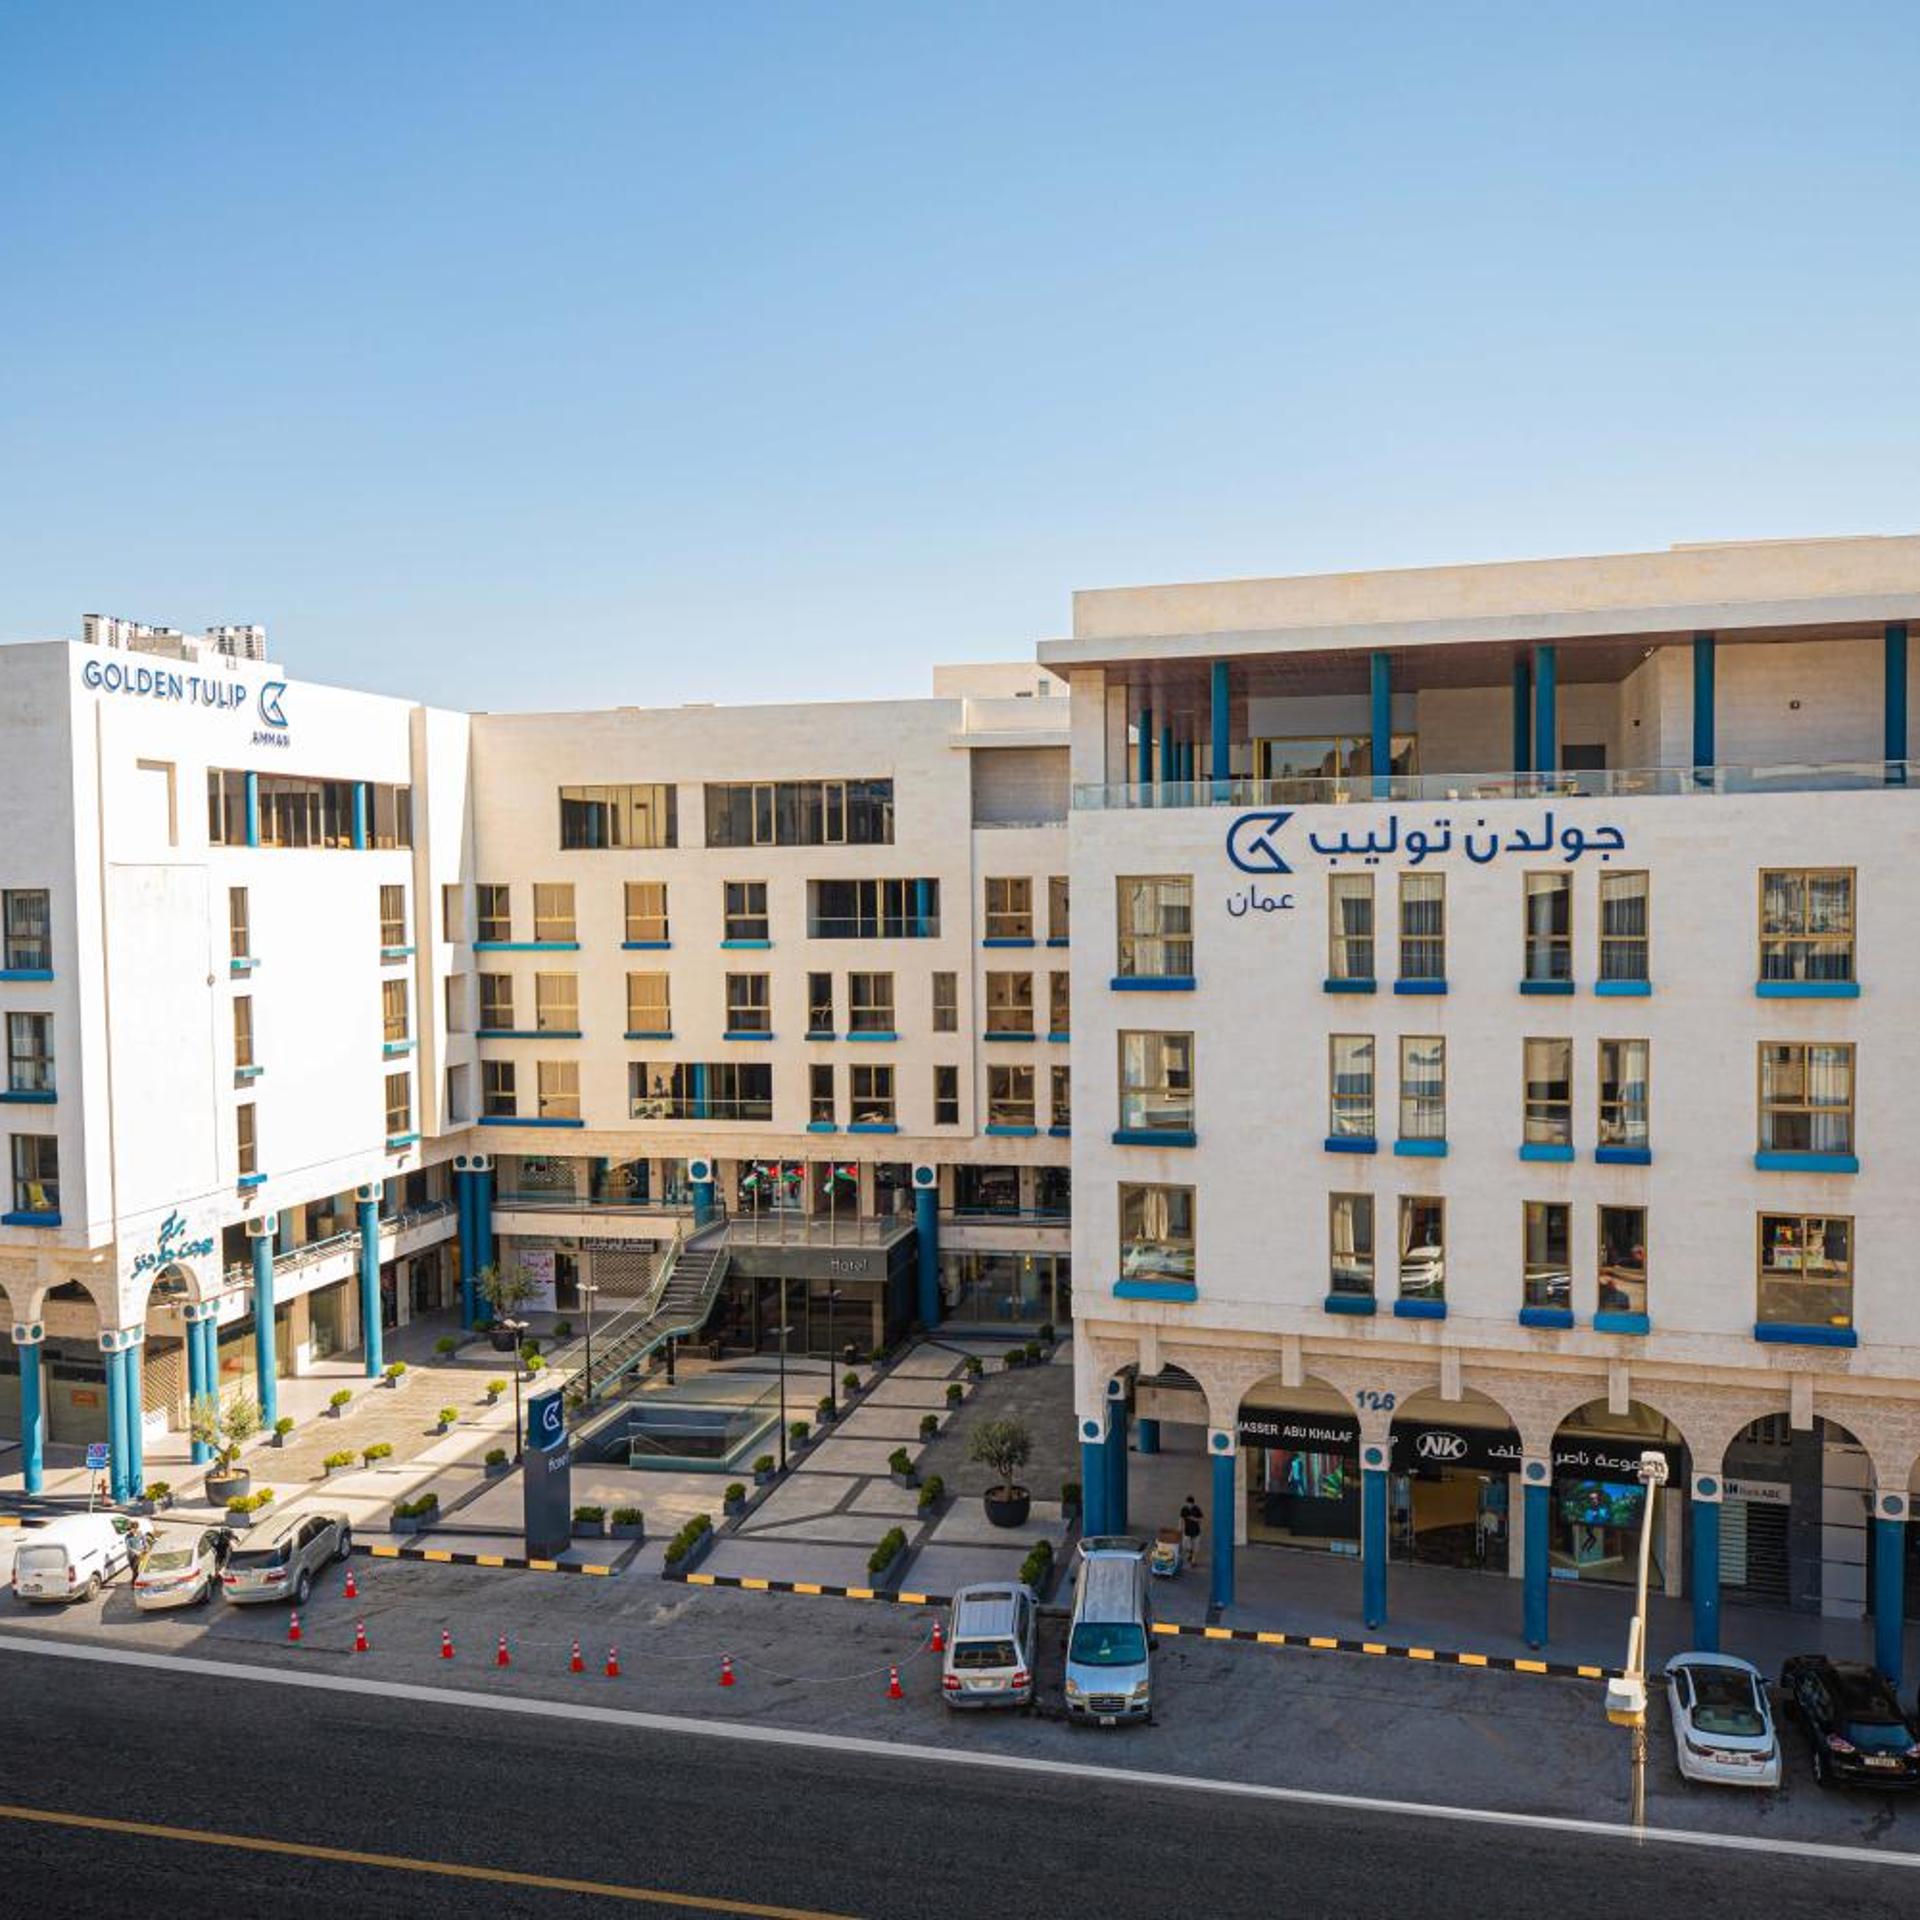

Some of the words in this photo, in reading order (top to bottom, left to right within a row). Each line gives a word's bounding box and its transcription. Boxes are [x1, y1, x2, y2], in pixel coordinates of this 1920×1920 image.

[83, 660, 184, 702] GOLDEN
[188, 676, 247, 710] TULIP
[251, 730, 290, 748] AMMAN
[1308, 815, 1451, 866] توليب
[1464, 811, 1626, 864] جولدن
[1226, 884, 1295, 917] عمان
[1356, 1390, 1395, 1411] 126
[1283, 1425, 1306, 1438] ABU
[1308, 1428, 1353, 1443] KHALAF
[1555, 1450, 1589, 1466] ناصر
